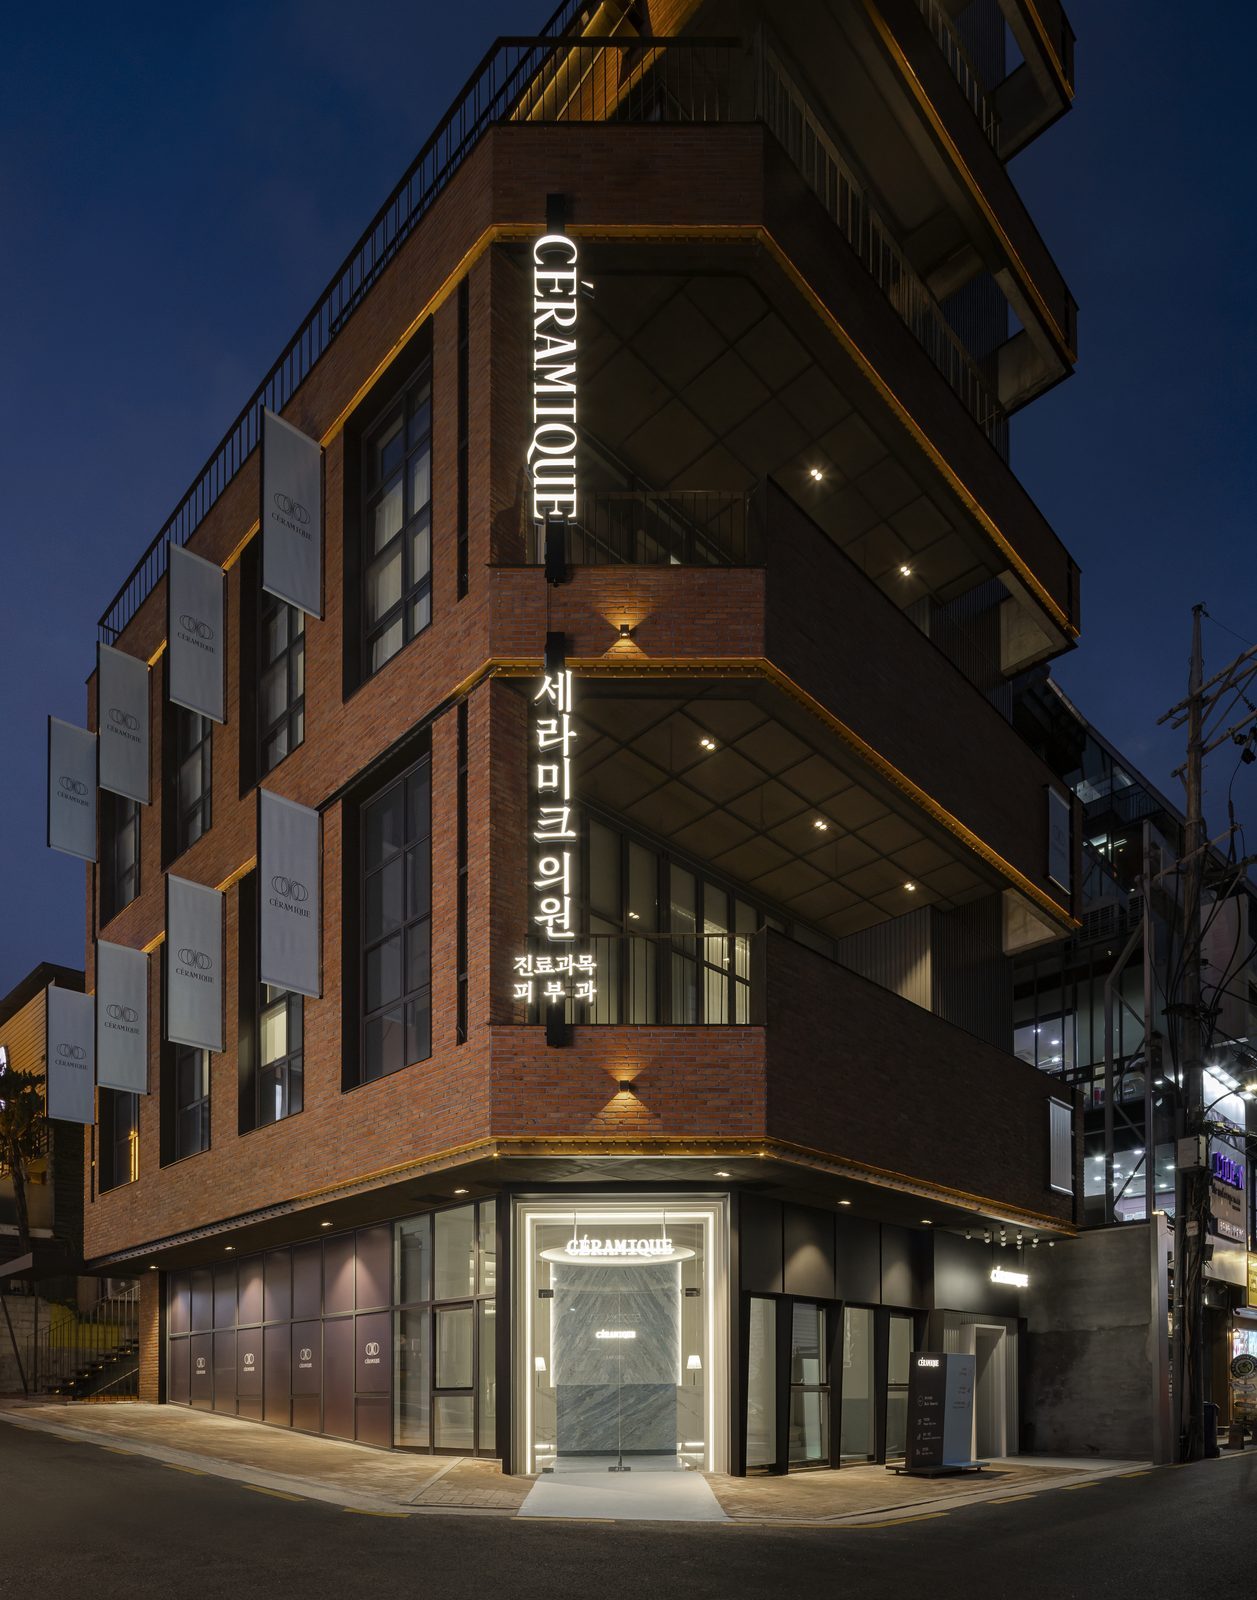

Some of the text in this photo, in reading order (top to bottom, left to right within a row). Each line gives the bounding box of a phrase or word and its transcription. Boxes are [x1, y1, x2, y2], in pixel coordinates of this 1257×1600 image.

[527, 234, 595, 519] CÉRAMIQUE
[271, 511, 313, 541] CÉRAMIQUE
[269, 897, 312, 919] CÉRAMIQUE
[513, 954, 598, 977] 진료과목
[565, 1234, 675, 1257] CÉRAMIQUE
